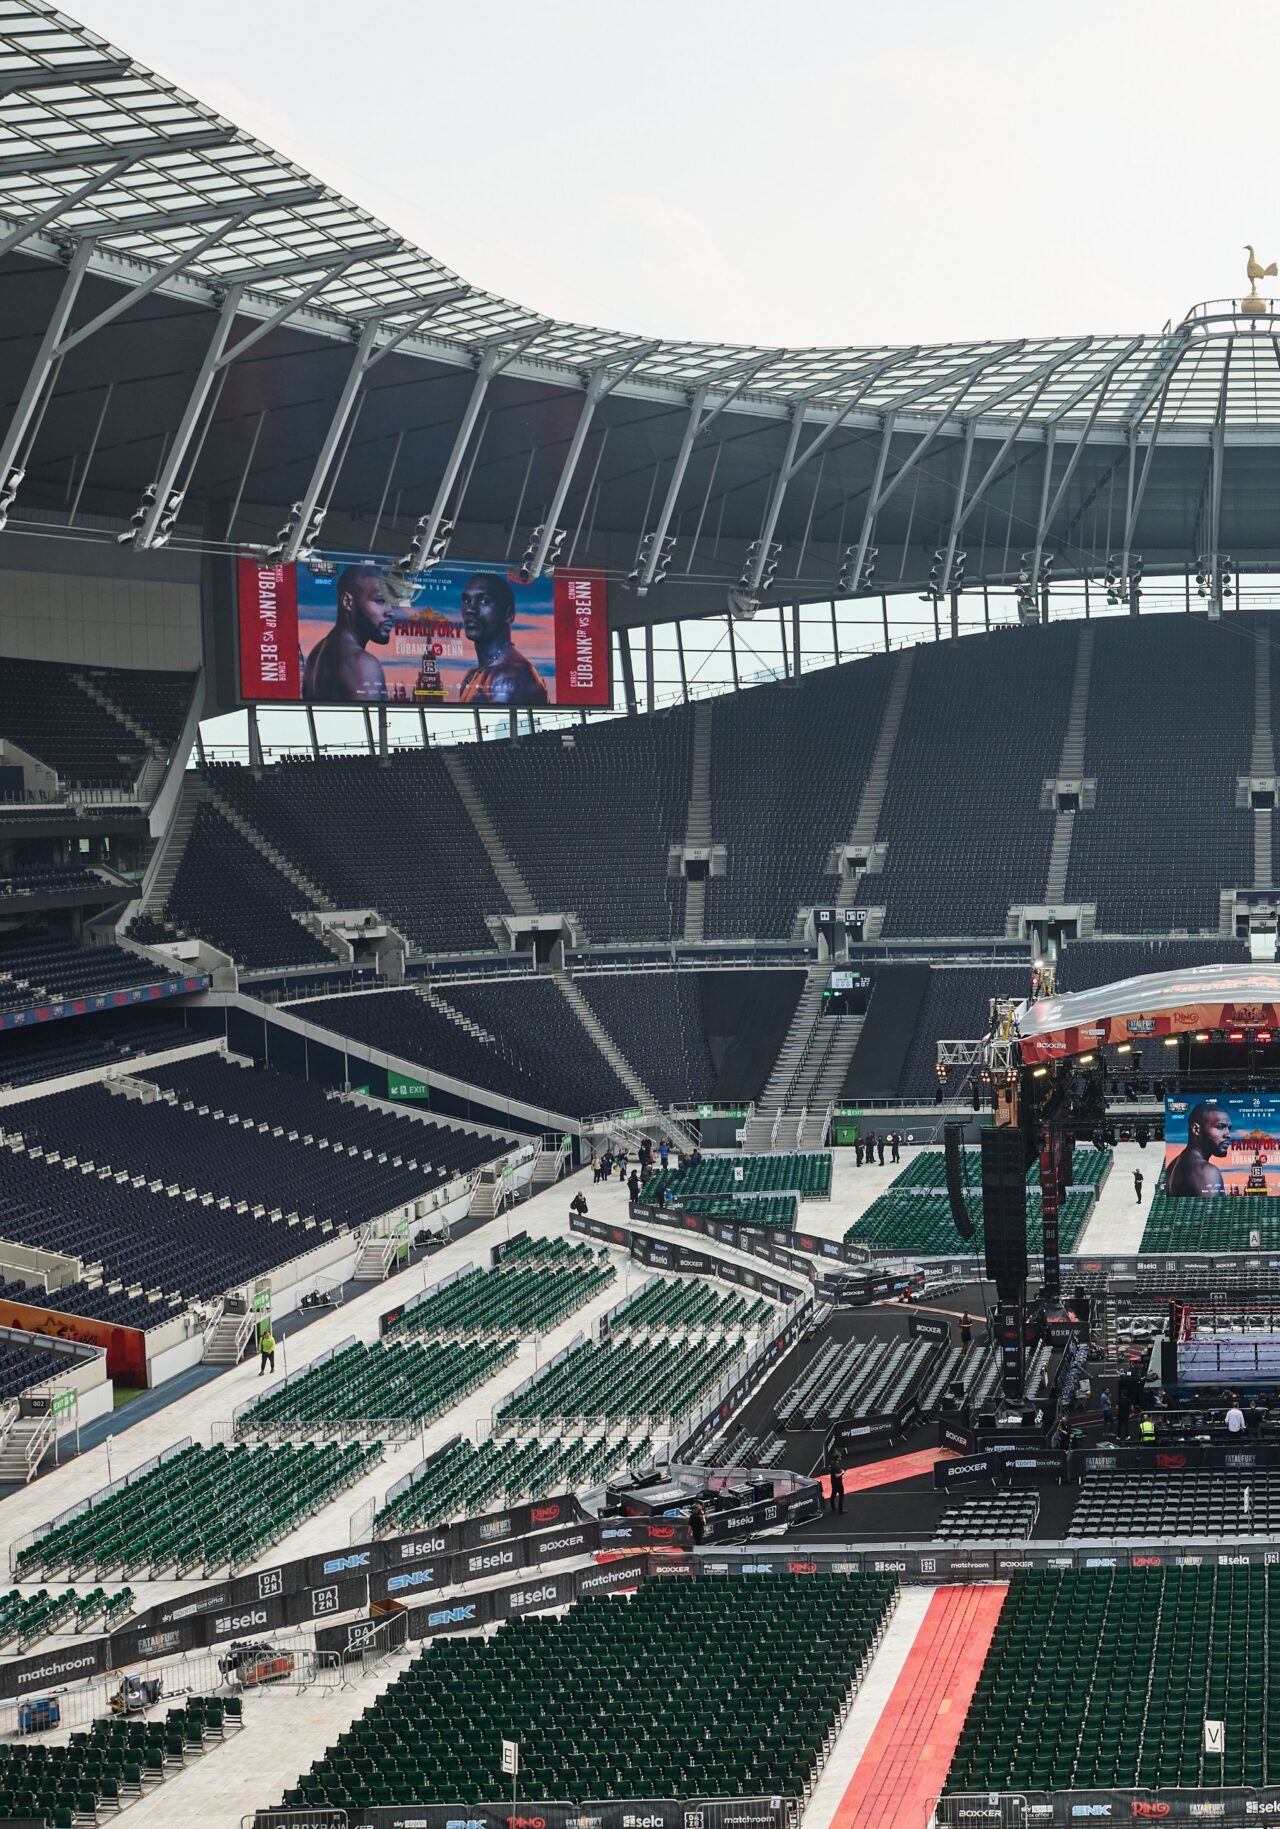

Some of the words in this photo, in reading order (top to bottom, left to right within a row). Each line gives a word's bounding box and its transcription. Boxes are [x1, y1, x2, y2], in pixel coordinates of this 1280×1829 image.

[258, 564, 277, 619] UBANK
[576, 581, 592, 615] BENN
[580, 617, 589, 627] VS
[262, 631, 274, 642] VS
[260, 644, 279, 682] BENN
[577, 638, 593, 687] EUBANK
[1174, 1012, 1199, 1025] RING
[409, 1086, 426, 1094] EXIT
[916, 1323, 942, 1336] BOXXER
[842, 1429, 851, 1437] sky
[945, 1430, 967, 1446] BOXXER
[1156, 1454, 1186, 1468] RING
[948, 1462, 987, 1476] BOXXER
[531, 1504, 560, 1522] RING
[736, 1516, 754, 1527] sela
[602, 1527, 632, 1538] SNK
[647, 1525, 675, 1538] RING
[415, 1537, 445, 1556] sela
[539, 1535, 584, 1552] BOXXER
[324, 1551, 370, 1575] SNK
[483, 1551, 513, 1569] sela
[885, 1561, 906, 1572] sela
[950, 1561, 989, 1569] matchroom
[1132, 1556, 1161, 1566] RING
[1228, 1555, 1249, 1565] sela
[742, 1564, 772, 1573] SNK
[787, 1562, 816, 1574] RING
[388, 1568, 434, 1591] SNK
[582, 1566, 641, 1590] matchroom
[525, 1586, 556, 1606] sela
[162, 1612, 173, 1623] sky
[207, 1596, 224, 1607] office
[428, 1604, 476, 1627] SNK
[232, 1610, 267, 1630] sela
[18, 1655, 96, 1684] matchroom
[1207, 1728, 1219, 1743] V
[505, 1748, 512, 1765] E
[959, 1809, 1002, 1818] BOXXER
[1071, 1804, 1112, 1817] SNK
[1131, 1800, 1170, 1819] RING
[1190, 1803, 1207, 1813] FATAL
[1208, 1803, 1225, 1813] FURY
[445, 1820, 487, 1829] SNK
[506, 1816, 546, 1829] RING
[636, 1815, 664, 1827] sela
[724, 1814, 775, 1824] matchroom
